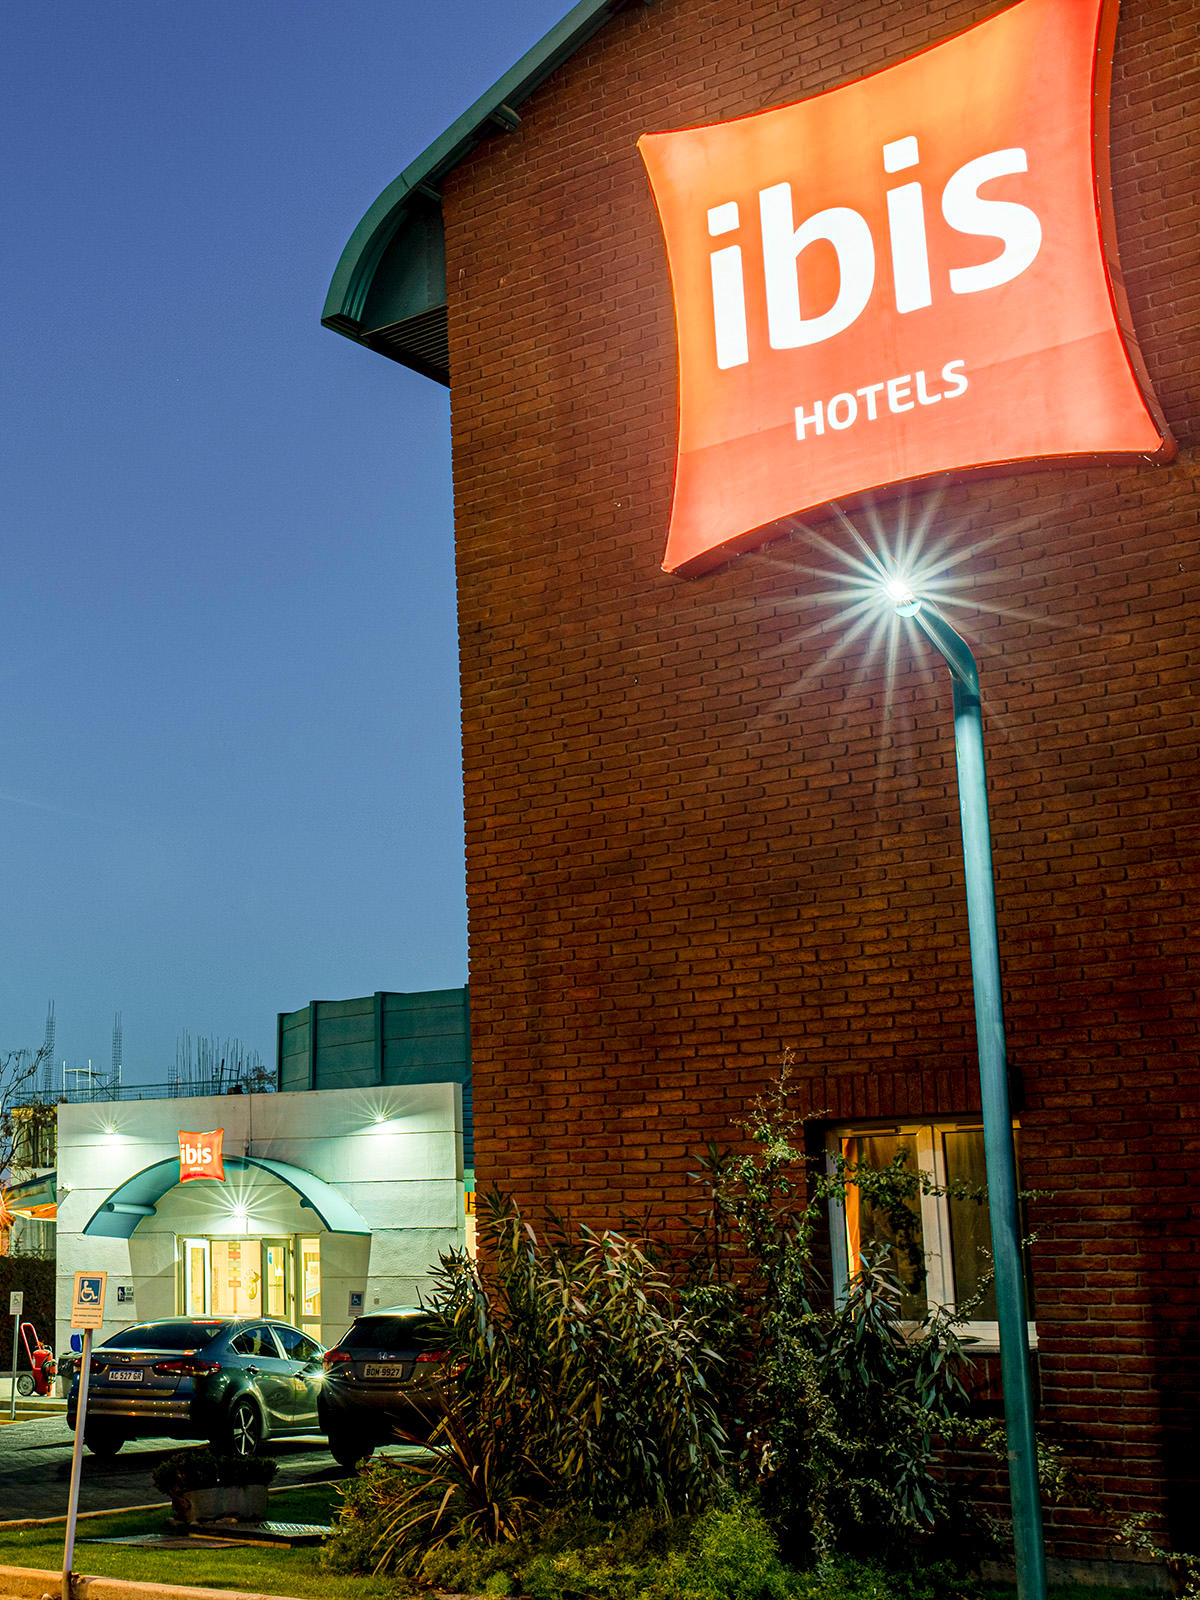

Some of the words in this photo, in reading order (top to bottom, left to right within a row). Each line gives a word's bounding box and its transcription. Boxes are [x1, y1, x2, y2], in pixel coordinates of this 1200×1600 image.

[707, 135, 1043, 370] ibis
[794, 359, 969, 441] HOTELS
[180, 1143, 212, 1164] ibis
